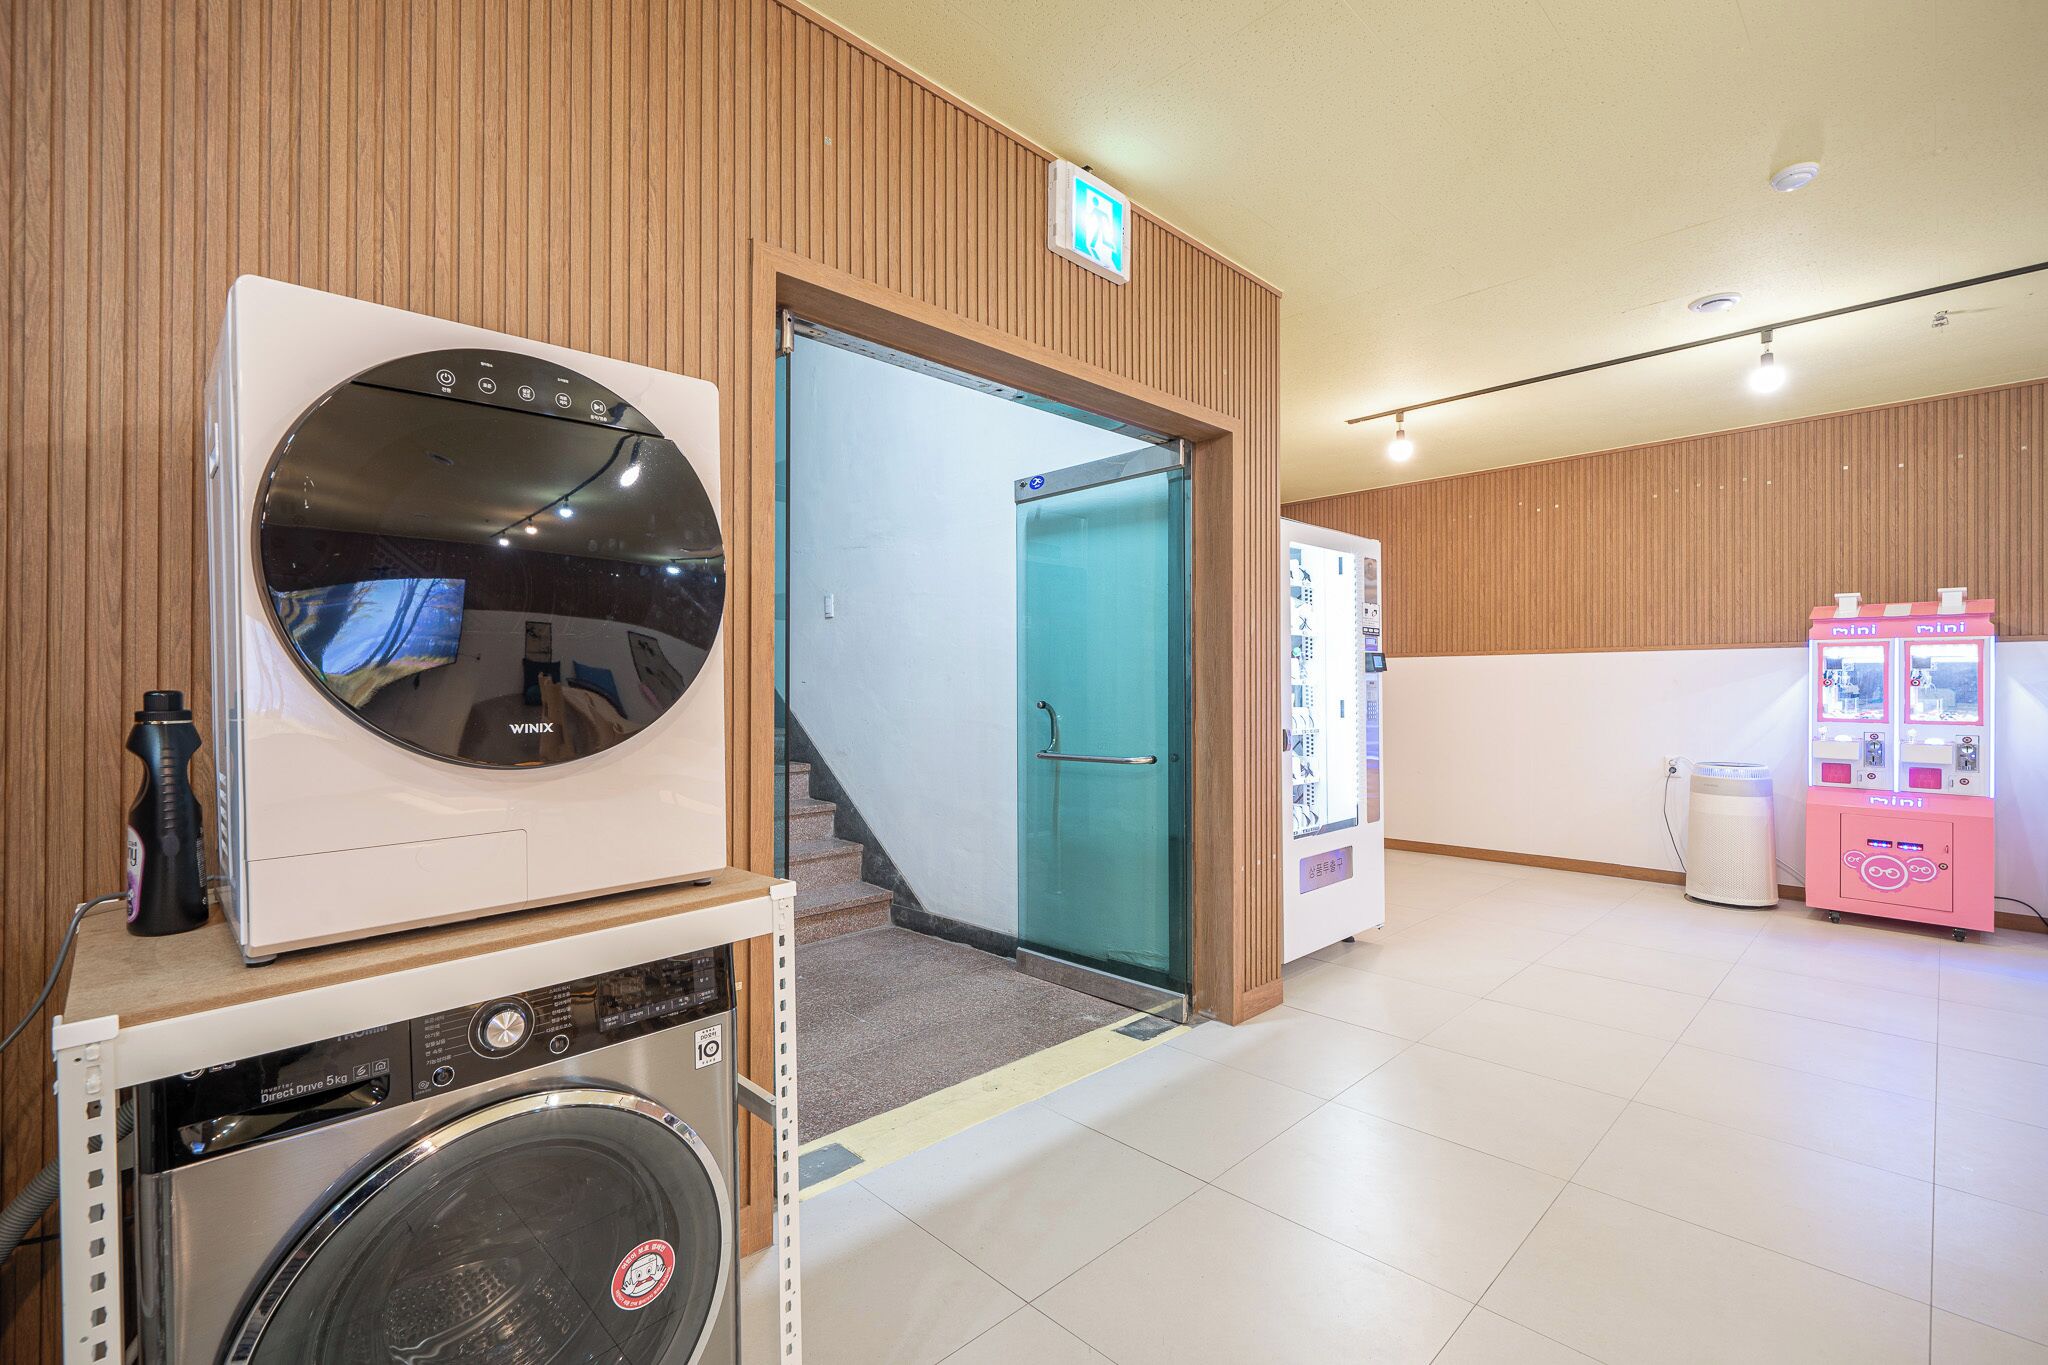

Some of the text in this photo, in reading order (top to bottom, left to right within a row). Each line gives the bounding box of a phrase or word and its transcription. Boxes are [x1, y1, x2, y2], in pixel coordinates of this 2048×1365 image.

[1832, 624, 1877, 636] mini
[1916, 621, 1966, 634] mini
[509, 722, 554, 734] WINIX
[1869, 796, 1923, 808] mini
[697, 1040, 720, 1061] 10
[260, 1082, 294, 1094] Inverter
[260, 1074, 348, 1104] Direct Drive 5kg
